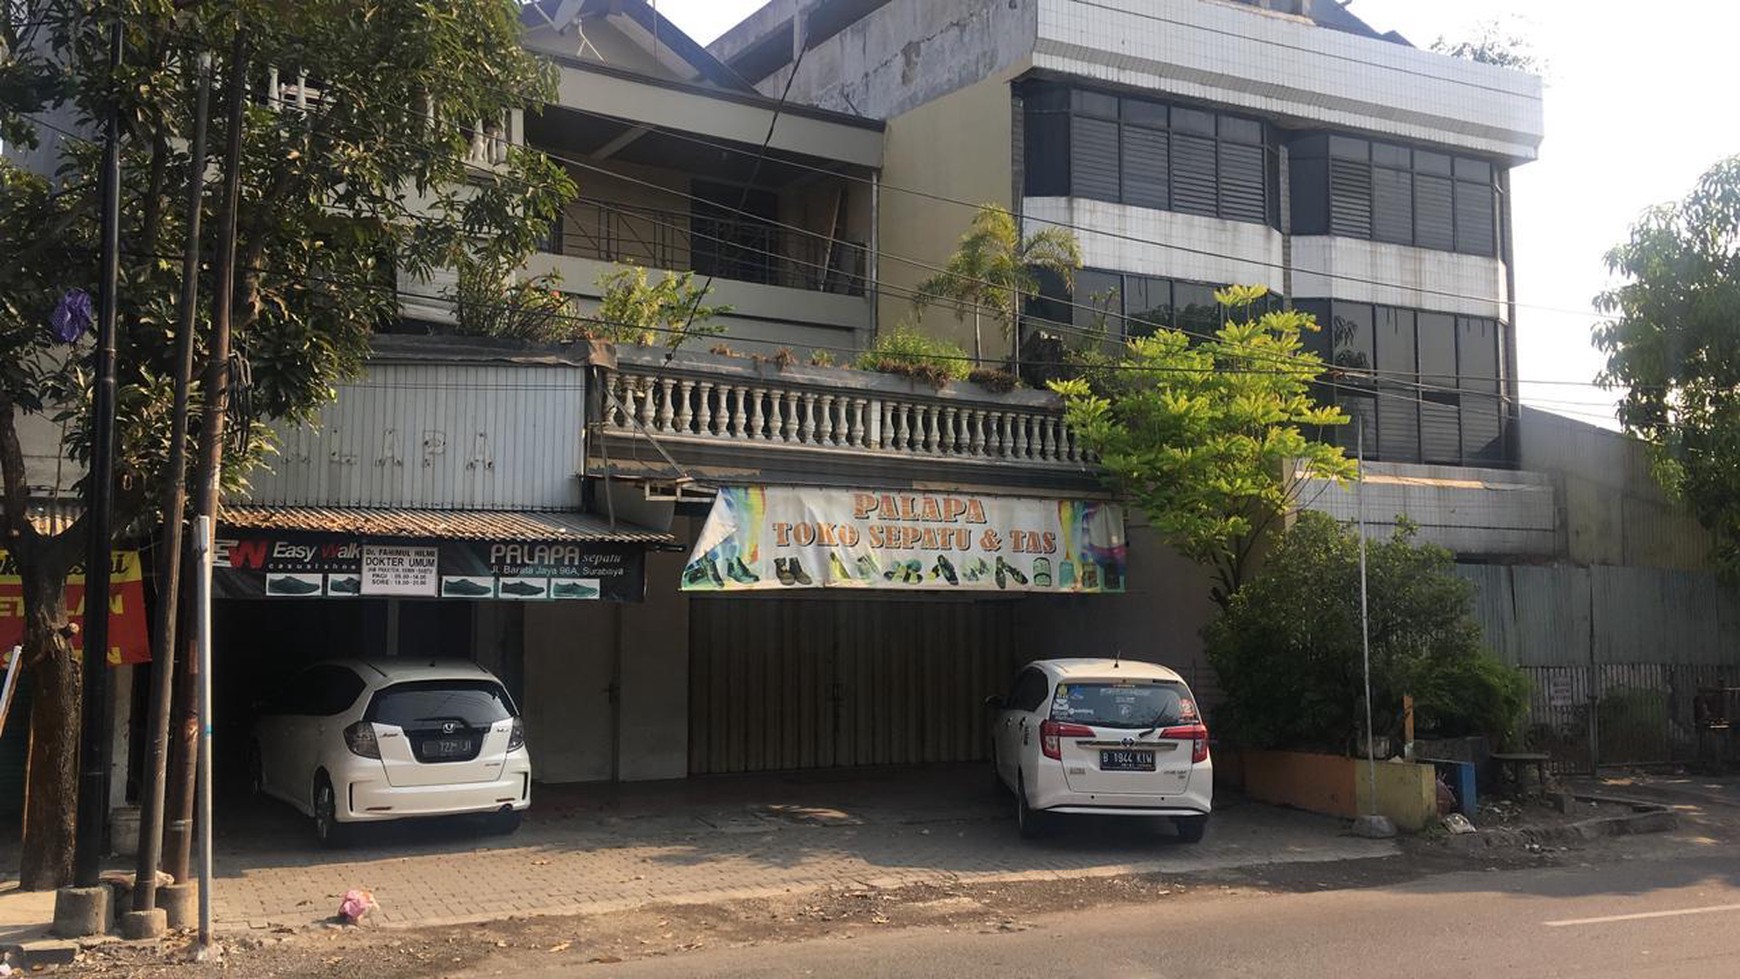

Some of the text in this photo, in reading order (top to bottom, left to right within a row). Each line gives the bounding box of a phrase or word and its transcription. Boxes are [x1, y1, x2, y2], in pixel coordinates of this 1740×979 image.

[853, 492, 988, 523] PALAPA
[772, 520, 1058, 554] TOKO SEPATU & TAS
[273, 541, 361, 562] Easy Walk
[490, 544, 622, 565] PALAPA sepatu
[268, 562, 318, 570] casual
[366, 556, 435, 567] DOKTER UMUM
[503, 565, 534, 575] Barata
[535, 566, 557, 577] Jaya
[582, 567, 624, 577] Surabaya
[1103, 752, 1109, 762] B
